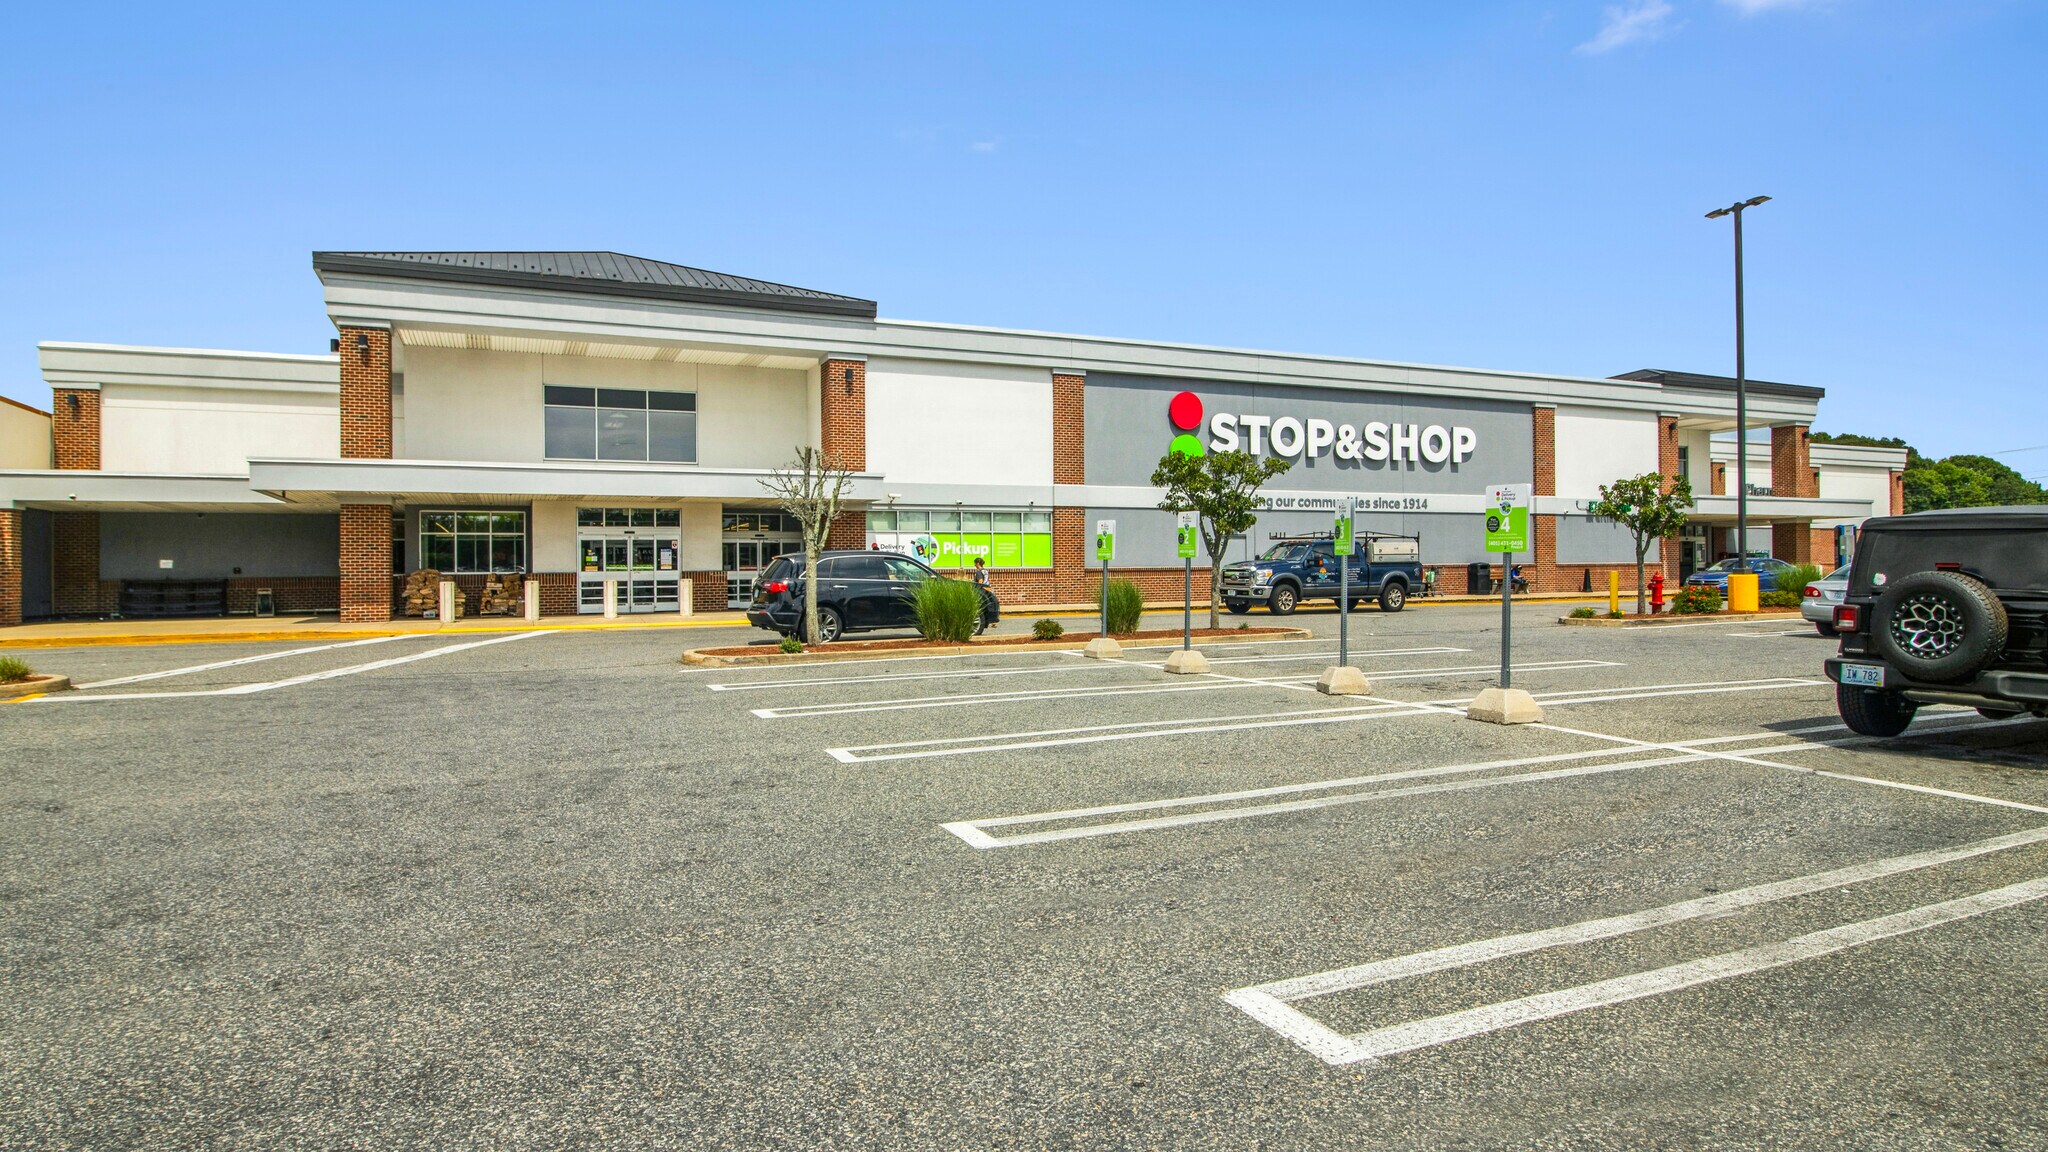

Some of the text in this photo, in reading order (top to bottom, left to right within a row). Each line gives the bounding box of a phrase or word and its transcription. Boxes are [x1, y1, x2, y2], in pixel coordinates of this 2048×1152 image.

[1209, 413, 1476, 463] STOP&SHOP
[1276, 497, 1295, 507] our
[1373, 497, 1400, 509] since
[1403, 498, 1428, 509] 1914
[1500, 517, 1510, 532] 4
[1184, 533, 1189, 544] 2
[1340, 526, 1345, 539] 3
[943, 541, 989, 558] Pickup
[1103, 539, 1106, 548] 1
[1862, 670, 1879, 681] 782
